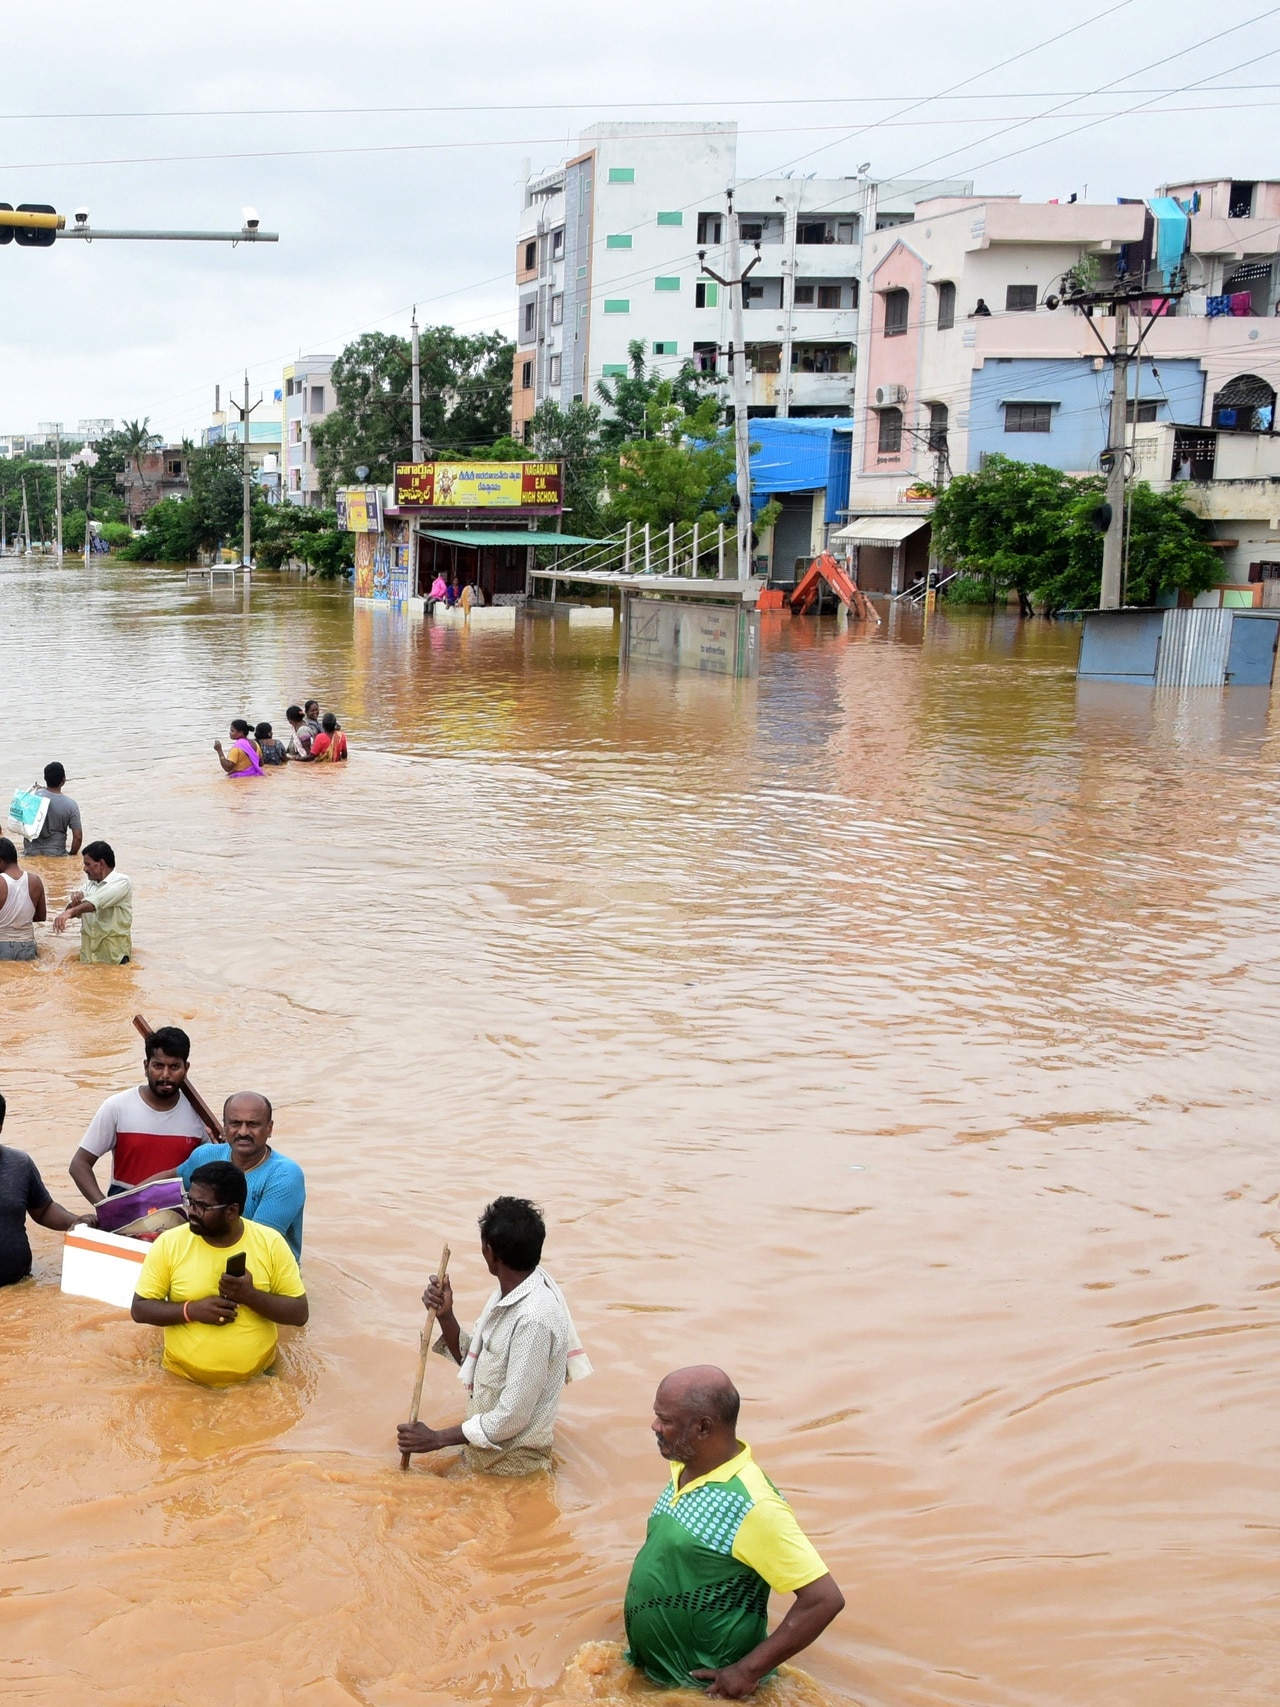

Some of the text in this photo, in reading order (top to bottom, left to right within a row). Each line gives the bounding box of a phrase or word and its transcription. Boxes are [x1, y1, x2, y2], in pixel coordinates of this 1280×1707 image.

[525, 464, 558, 476] NAGARJUNA
[522, 491, 536, 502] HIGH
[536, 491, 559, 503] SCHOOL
